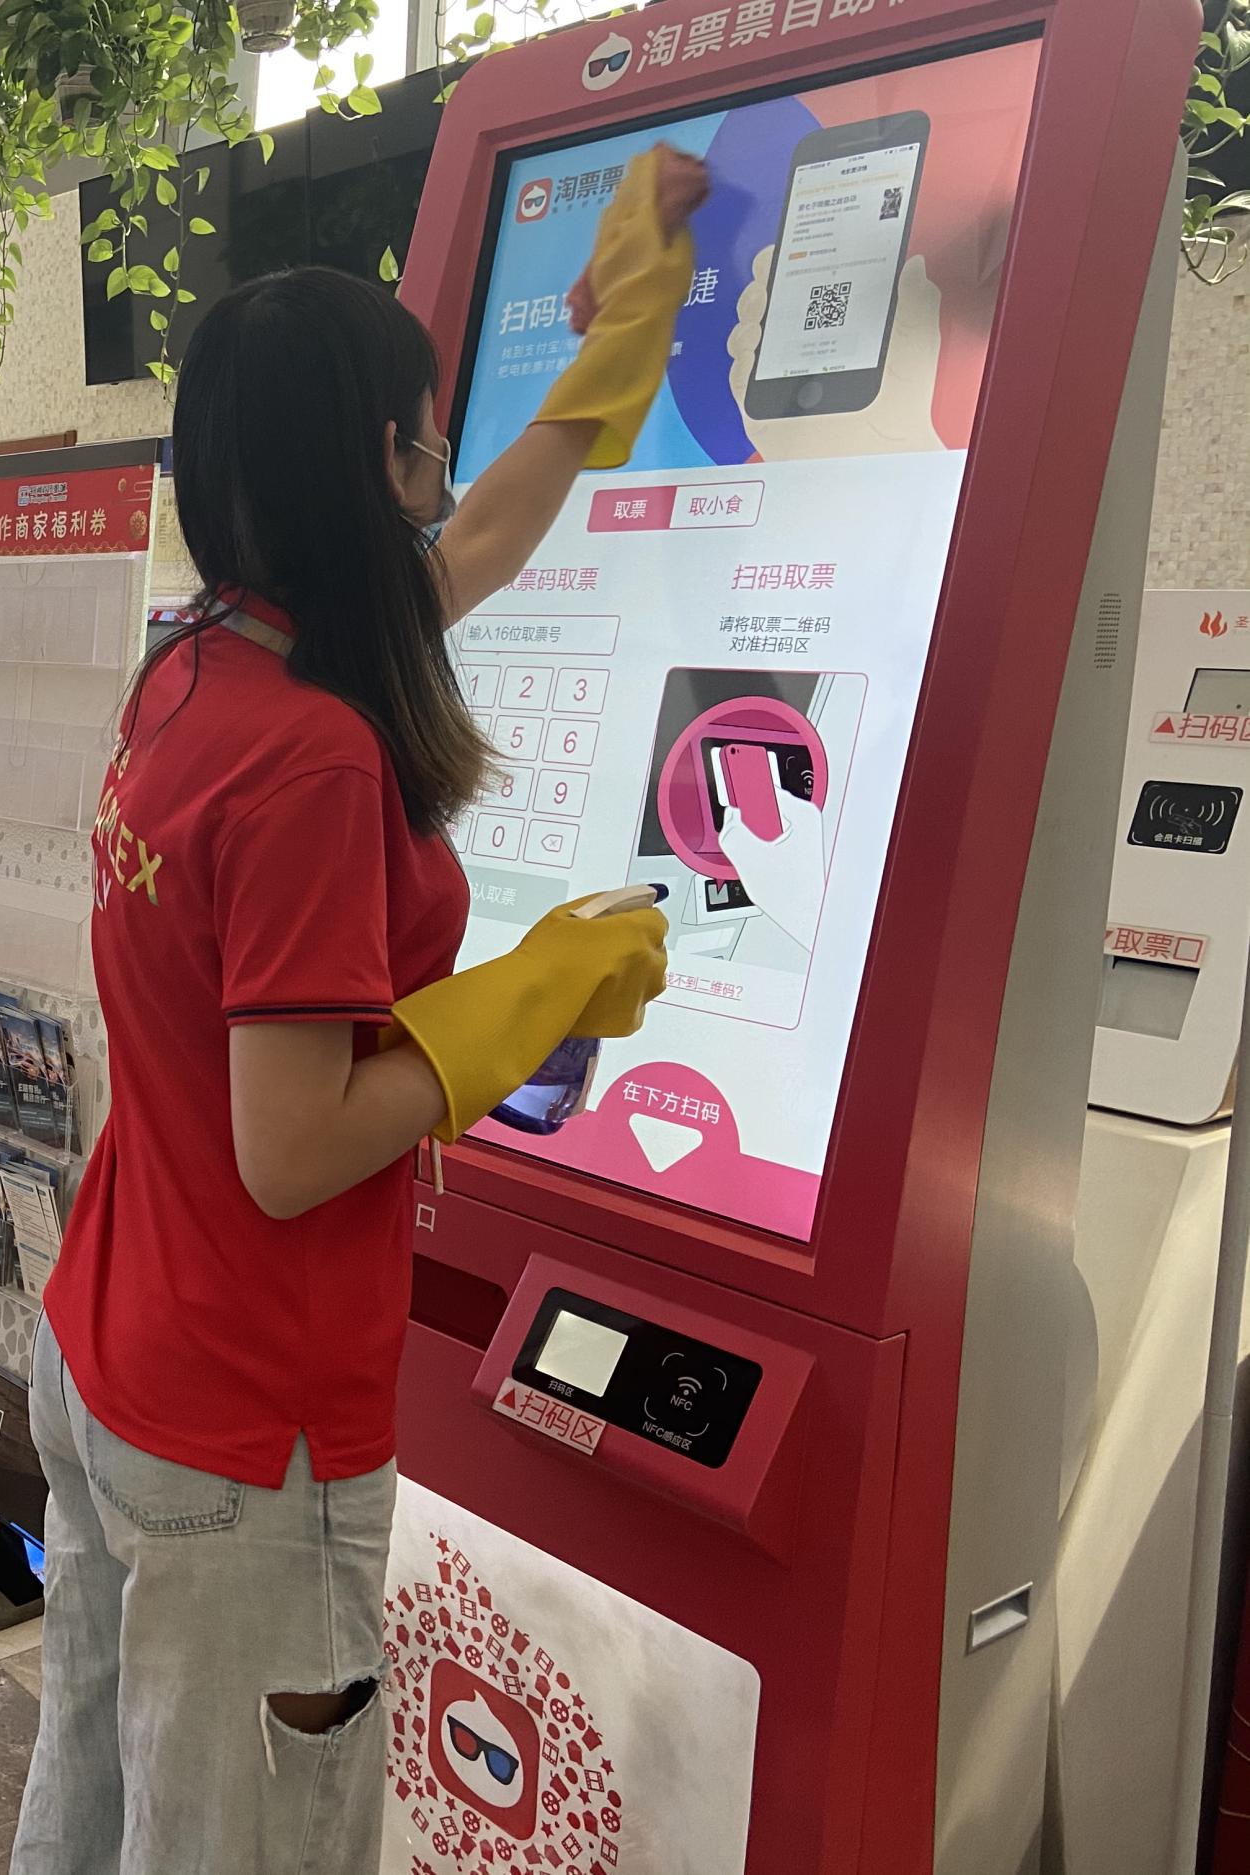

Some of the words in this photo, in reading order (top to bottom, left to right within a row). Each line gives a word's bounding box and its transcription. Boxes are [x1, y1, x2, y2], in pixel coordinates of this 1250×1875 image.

[636, 0, 904, 73] 淘票票自
[554, 164, 625, 203] 淘票票
[613, 499, 648, 519] 取票
[689, 494, 743, 516] 取小食
[731, 563, 837, 590] 扫码取票
[468, 625, 562, 643] 输入16位取票号
[718, 615, 831, 634] 请将取票二维码
[728, 635, 811, 654] 对准扫码区
[518, 675, 535, 699] 2
[572, 678, 588, 702] 3
[509, 726, 525, 749] 5
[563, 730, 578, 754] 6
[501, 774, 515, 798] 8
[553, 781, 568, 805] 9
[492, 825, 505, 848] 0
[471, 882, 517, 906] 认取票
[1112, 927, 1204, 963] 取票口
[622, 1080, 720, 1125] 在下方扫码
[547, 1380, 575, 1398] 扫码区
[670, 1394, 693, 1411] NFC
[519, 1389, 604, 1450] 扫码区
[642, 1421, 693, 1451] NFC感应区
